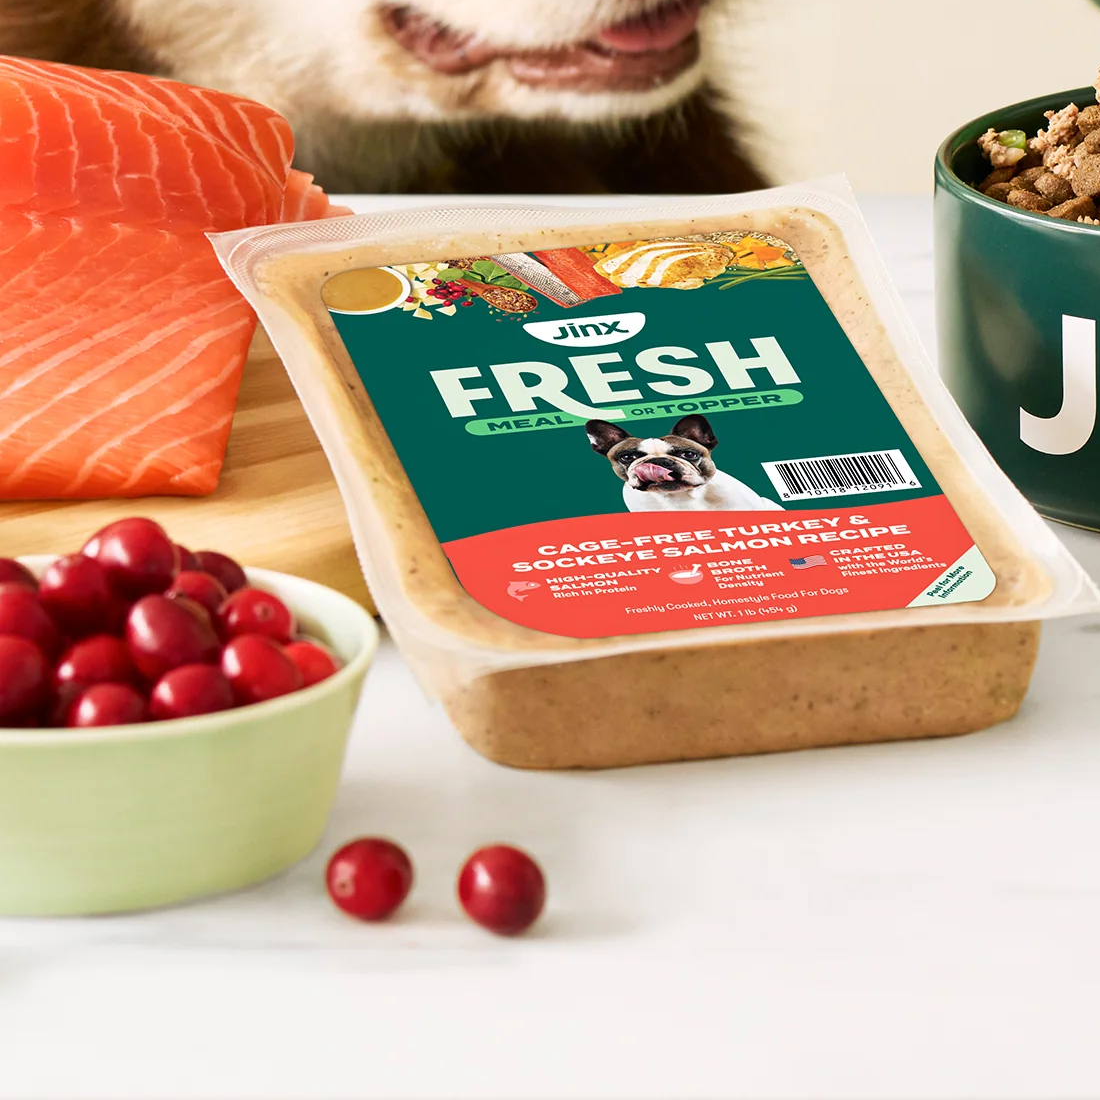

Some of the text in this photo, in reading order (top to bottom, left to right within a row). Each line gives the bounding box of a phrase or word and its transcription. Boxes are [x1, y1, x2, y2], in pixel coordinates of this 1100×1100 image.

[429, 336, 802, 419] FRESH
[486, 393, 783, 432] MEAL OR TOPPER
[537, 514, 871, 556] CAGE-FREE TURKEY &
[512, 524, 911, 572] SOCKEYE SALMON RECIPE
[829, 543, 906, 556] CRAFTED
[852, 552, 886, 561] THE
[887, 549, 922, 557] USA
[707, 558, 753, 568] BONE
[710, 564, 768, 576] BROTH
[838, 555, 933, 571] with the World's
[841, 561, 947, 577] Finest Ingredients
[545, 567, 661, 584] HIGH-QUALITY
[714, 570, 785, 583] For Nutrient
[926, 585, 943, 597] Peel
[946, 565, 965, 579] More
[549, 580, 619, 591] SALMON
[594, 585, 637, 595] Protein
[718, 580, 765, 589] Density
[938, 570, 973, 598] Information
[625, 605, 665, 614] Freshly
[666, 600, 712, 610] Cooked,
[712, 594, 770, 606] Homestyle
[771, 591, 799, 600] Food
[820, 586, 849, 596] Dogs
[693, 612, 715, 621] NET
[715, 610, 736, 619] WT.
[758, 606, 783, 615] (454
[786, 604, 798, 613] g)
